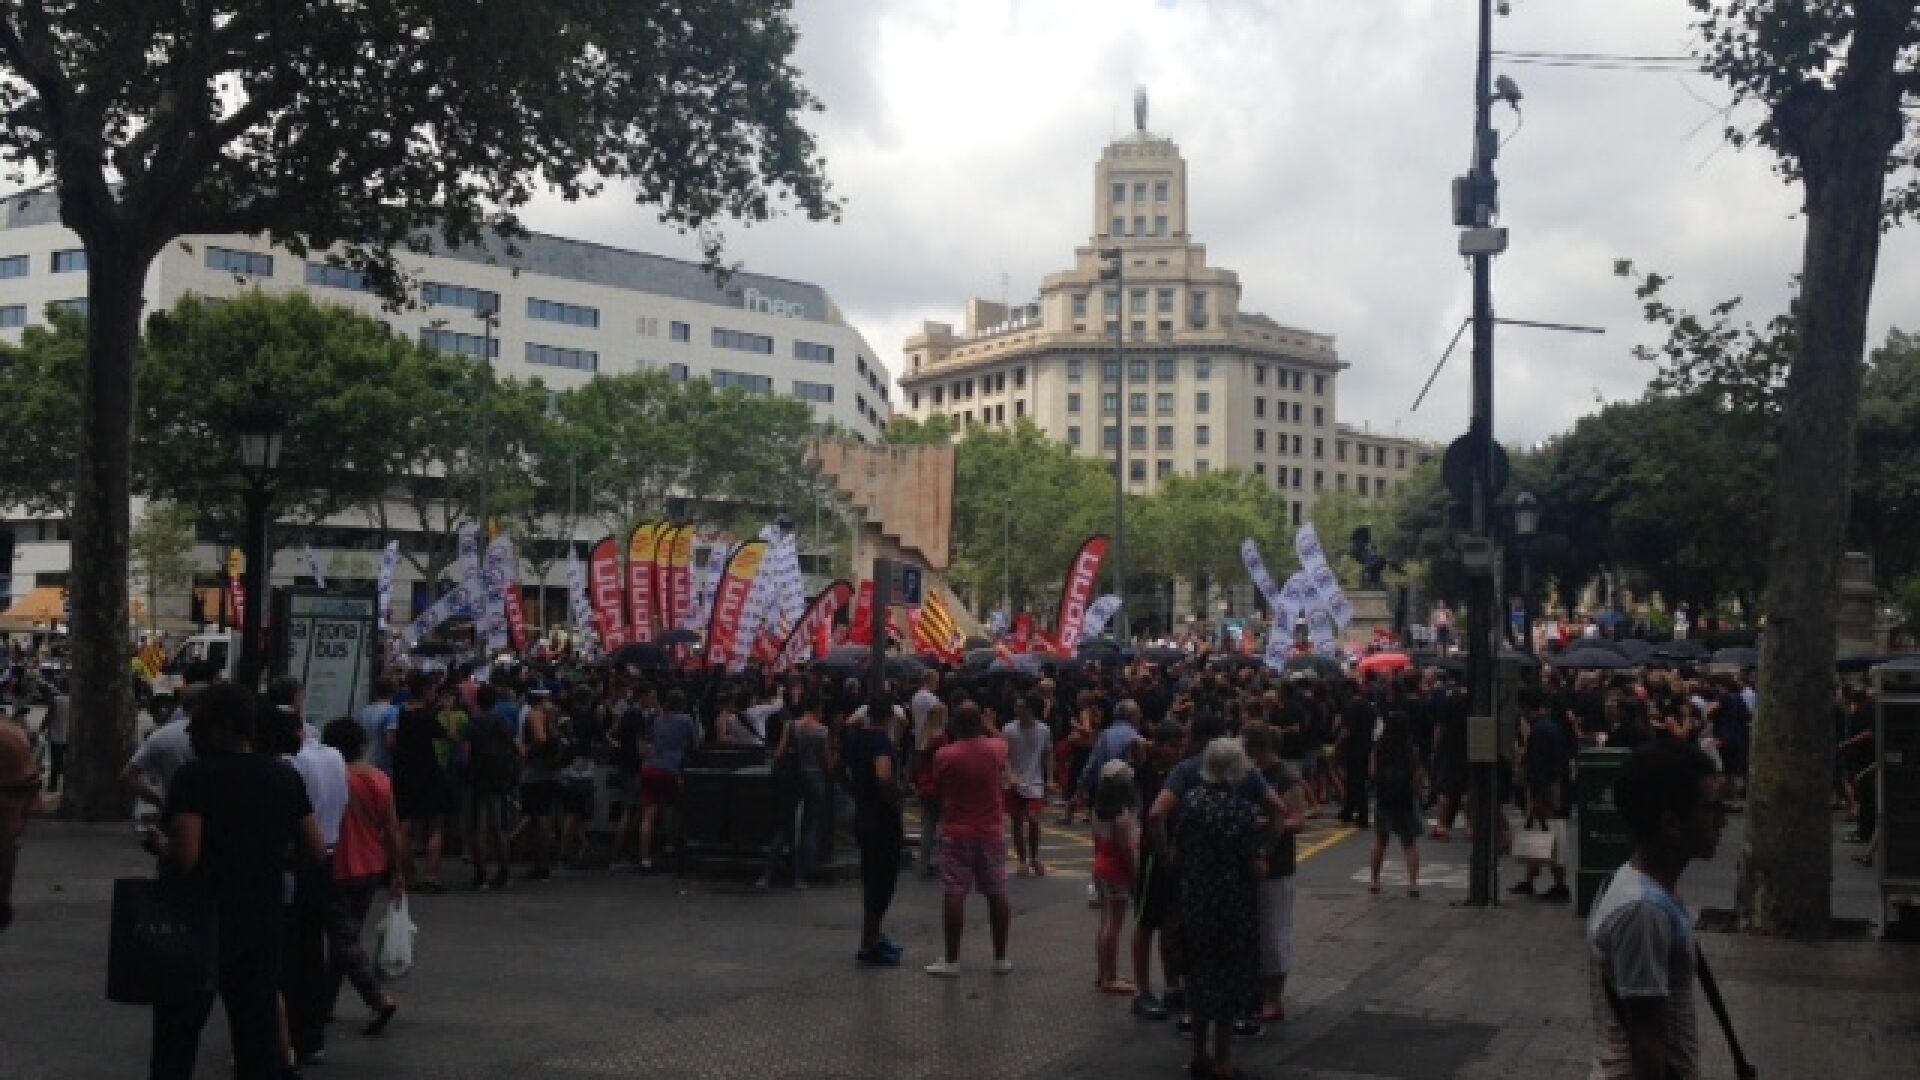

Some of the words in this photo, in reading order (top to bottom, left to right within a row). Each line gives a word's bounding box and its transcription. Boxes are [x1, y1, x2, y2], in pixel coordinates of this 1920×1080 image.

[744, 287, 805, 318] fnac
[631, 566, 652, 643] CCOO
[1061, 551, 1099, 648] CCOO
[314, 641, 348, 658] bus
